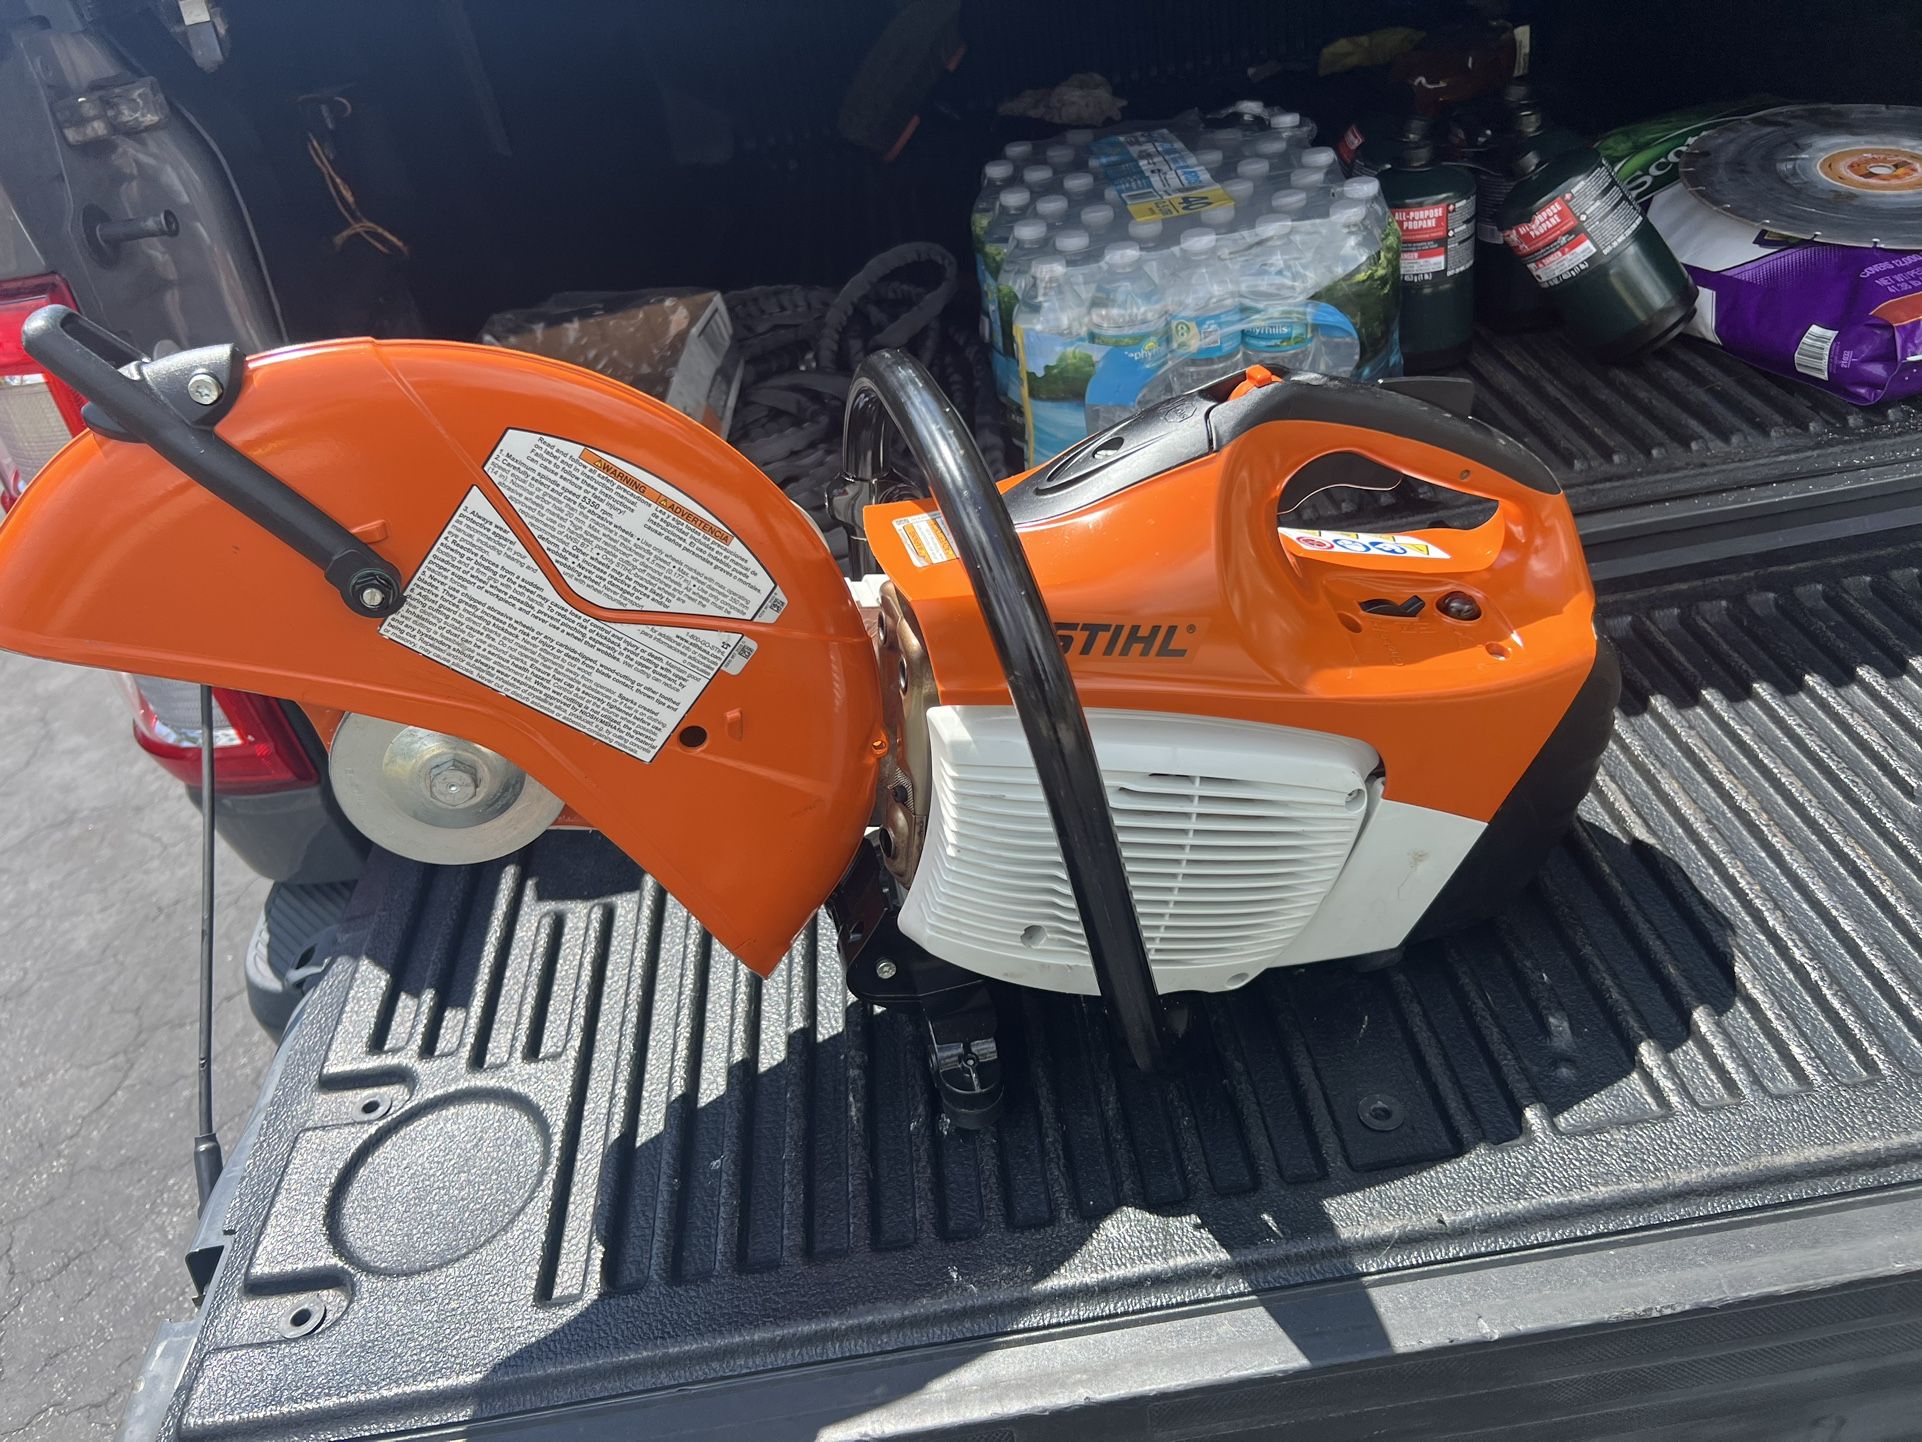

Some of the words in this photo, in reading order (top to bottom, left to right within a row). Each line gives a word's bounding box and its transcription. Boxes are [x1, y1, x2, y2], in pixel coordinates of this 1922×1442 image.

[1621, 135, 1702, 199] Sco
[1394, 207, 1443, 221] ALL-PURPOSE
[1403, 218, 1437, 230] PROPANE
[1530, 215, 1562, 239] PROPANE
[1860, 261, 1894, 277] COVERS
[1875, 276, 1895, 287] NET
[505, 452, 537, 474] Maximum
[536, 471, 561, 488] spindle
[560, 485, 582, 500] speed
[580, 495, 601, 511] 5350
[525, 454, 540, 465] can
[539, 462, 559, 477] cause
[558, 474, 583, 491] serious
[582, 488, 591, 496] or
[590, 492, 606, 505] fatal
[604, 500, 626, 517] injury!
[530, 448, 554, 465] Failure
[552, 461, 561, 470] to
[560, 466, 581, 482] follow
[580, 477, 599, 492] these
[598, 488, 636, 514] instructions
[533, 442, 544, 452] on
[543, 447, 561, 461] label
[559, 458, 574, 469] and
[572, 465, 581, 473] in
[579, 469, 615, 494] instruction
[537, 436, 556, 450] Read
[555, 447, 569, 458] and
[568, 454, 589, 470] follow
[588, 467, 598, 475] all
[596, 472, 617, 488] safety
[615, 483, 653, 509] precautions
[601, 463, 648, 495] WARNING
[454, 518, 464, 526] as
[463, 523, 507, 550] recommended
[506, 545, 514, 553] in
[512, 550, 527, 561] your
[457, 513, 492, 534] protective
[491, 530, 517, 547] apparel
[469, 509, 494, 526] Always
[493, 523, 510, 535] wear
[650, 511, 660, 520] de
[659, 516, 690, 537] seguridad
[688, 533, 716, 553] incluidas
[714, 549, 724, 557] en
[729, 557, 752, 573] manual
[749, 568, 759, 578] de
[654, 505, 667, 516] Lea
[671, 516, 685, 527] siga
[684, 523, 702, 537] todas
[701, 533, 712, 542] las
[710, 539, 749, 564] precauciones
[667, 502, 731, 543] ADVERTENCIA
[450, 539, 479, 558] Reactive
[478, 554, 500, 569] forces
[499, 565, 516, 578] from
[520, 577, 545, 593] sudden
[643, 522, 665, 538] causar
[663, 533, 683, 548] daños
[681, 545, 714, 567] personales
[713, 563, 734, 578] graves
[688, 540, 697, 549] El
[695, 545, 708, 556] uso
[706, 551, 733, 570] indebido
[730, 566, 750, 581] puede
[571, 544, 590, 558] Other
[589, 555, 611, 571] wheels
[610, 567, 625, 579] may
[624, 574, 634, 583] be
[632, 579, 649, 592] more
[648, 587, 665, 601] likely
[664, 596, 672, 605] to
[576, 562, 595, 576] Never
[594, 573, 607, 583] use
[606, 579, 635, 599] damaged
[633, 595, 642, 603] or
[581, 557, 608, 576] increase
[607, 572, 632, 589] reactive
[631, 585, 651, 600] forces
[650, 596, 670, 610] and/or
